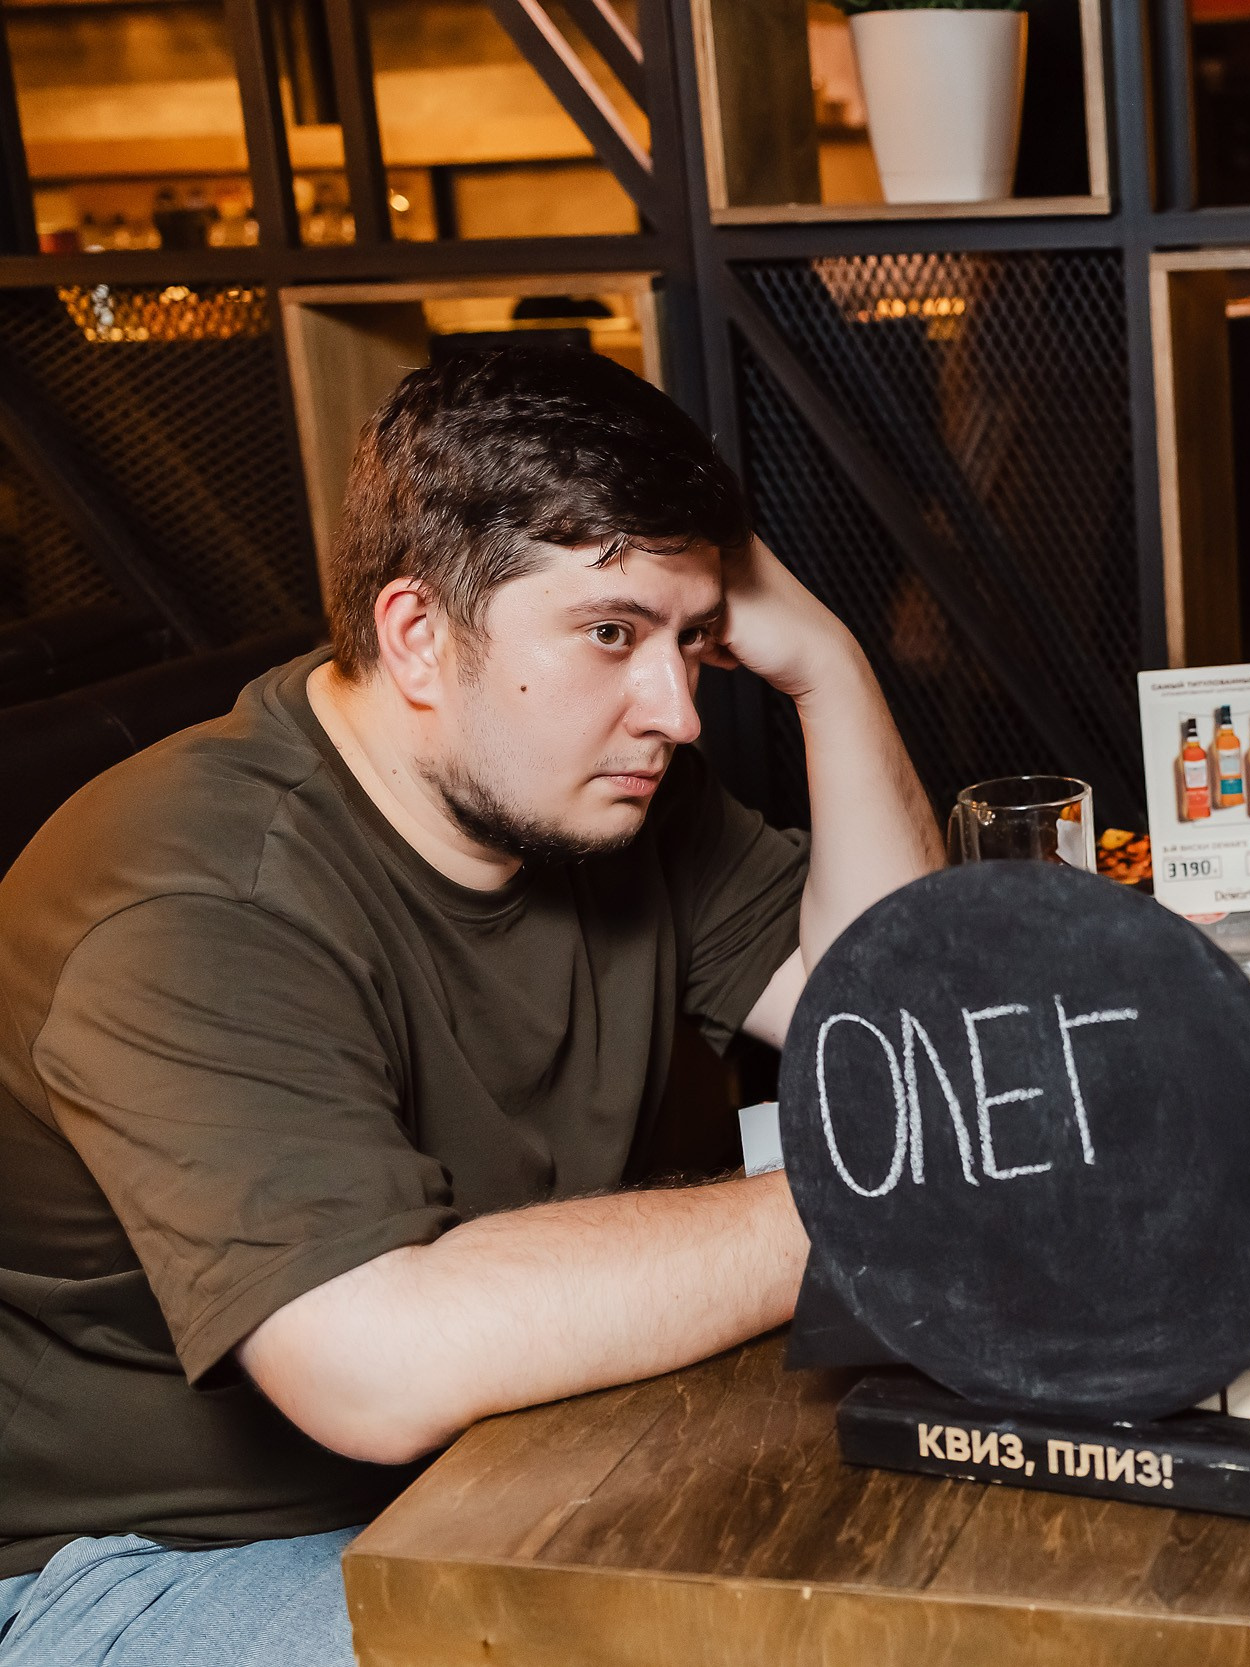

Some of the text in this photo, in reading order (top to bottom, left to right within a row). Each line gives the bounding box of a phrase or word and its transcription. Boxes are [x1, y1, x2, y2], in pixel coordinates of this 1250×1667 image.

[816, 994, 1138, 1197] ОЛЕГ
[917, 1422, 1175, 1490] КВИЗ, ПЛИЗ!
